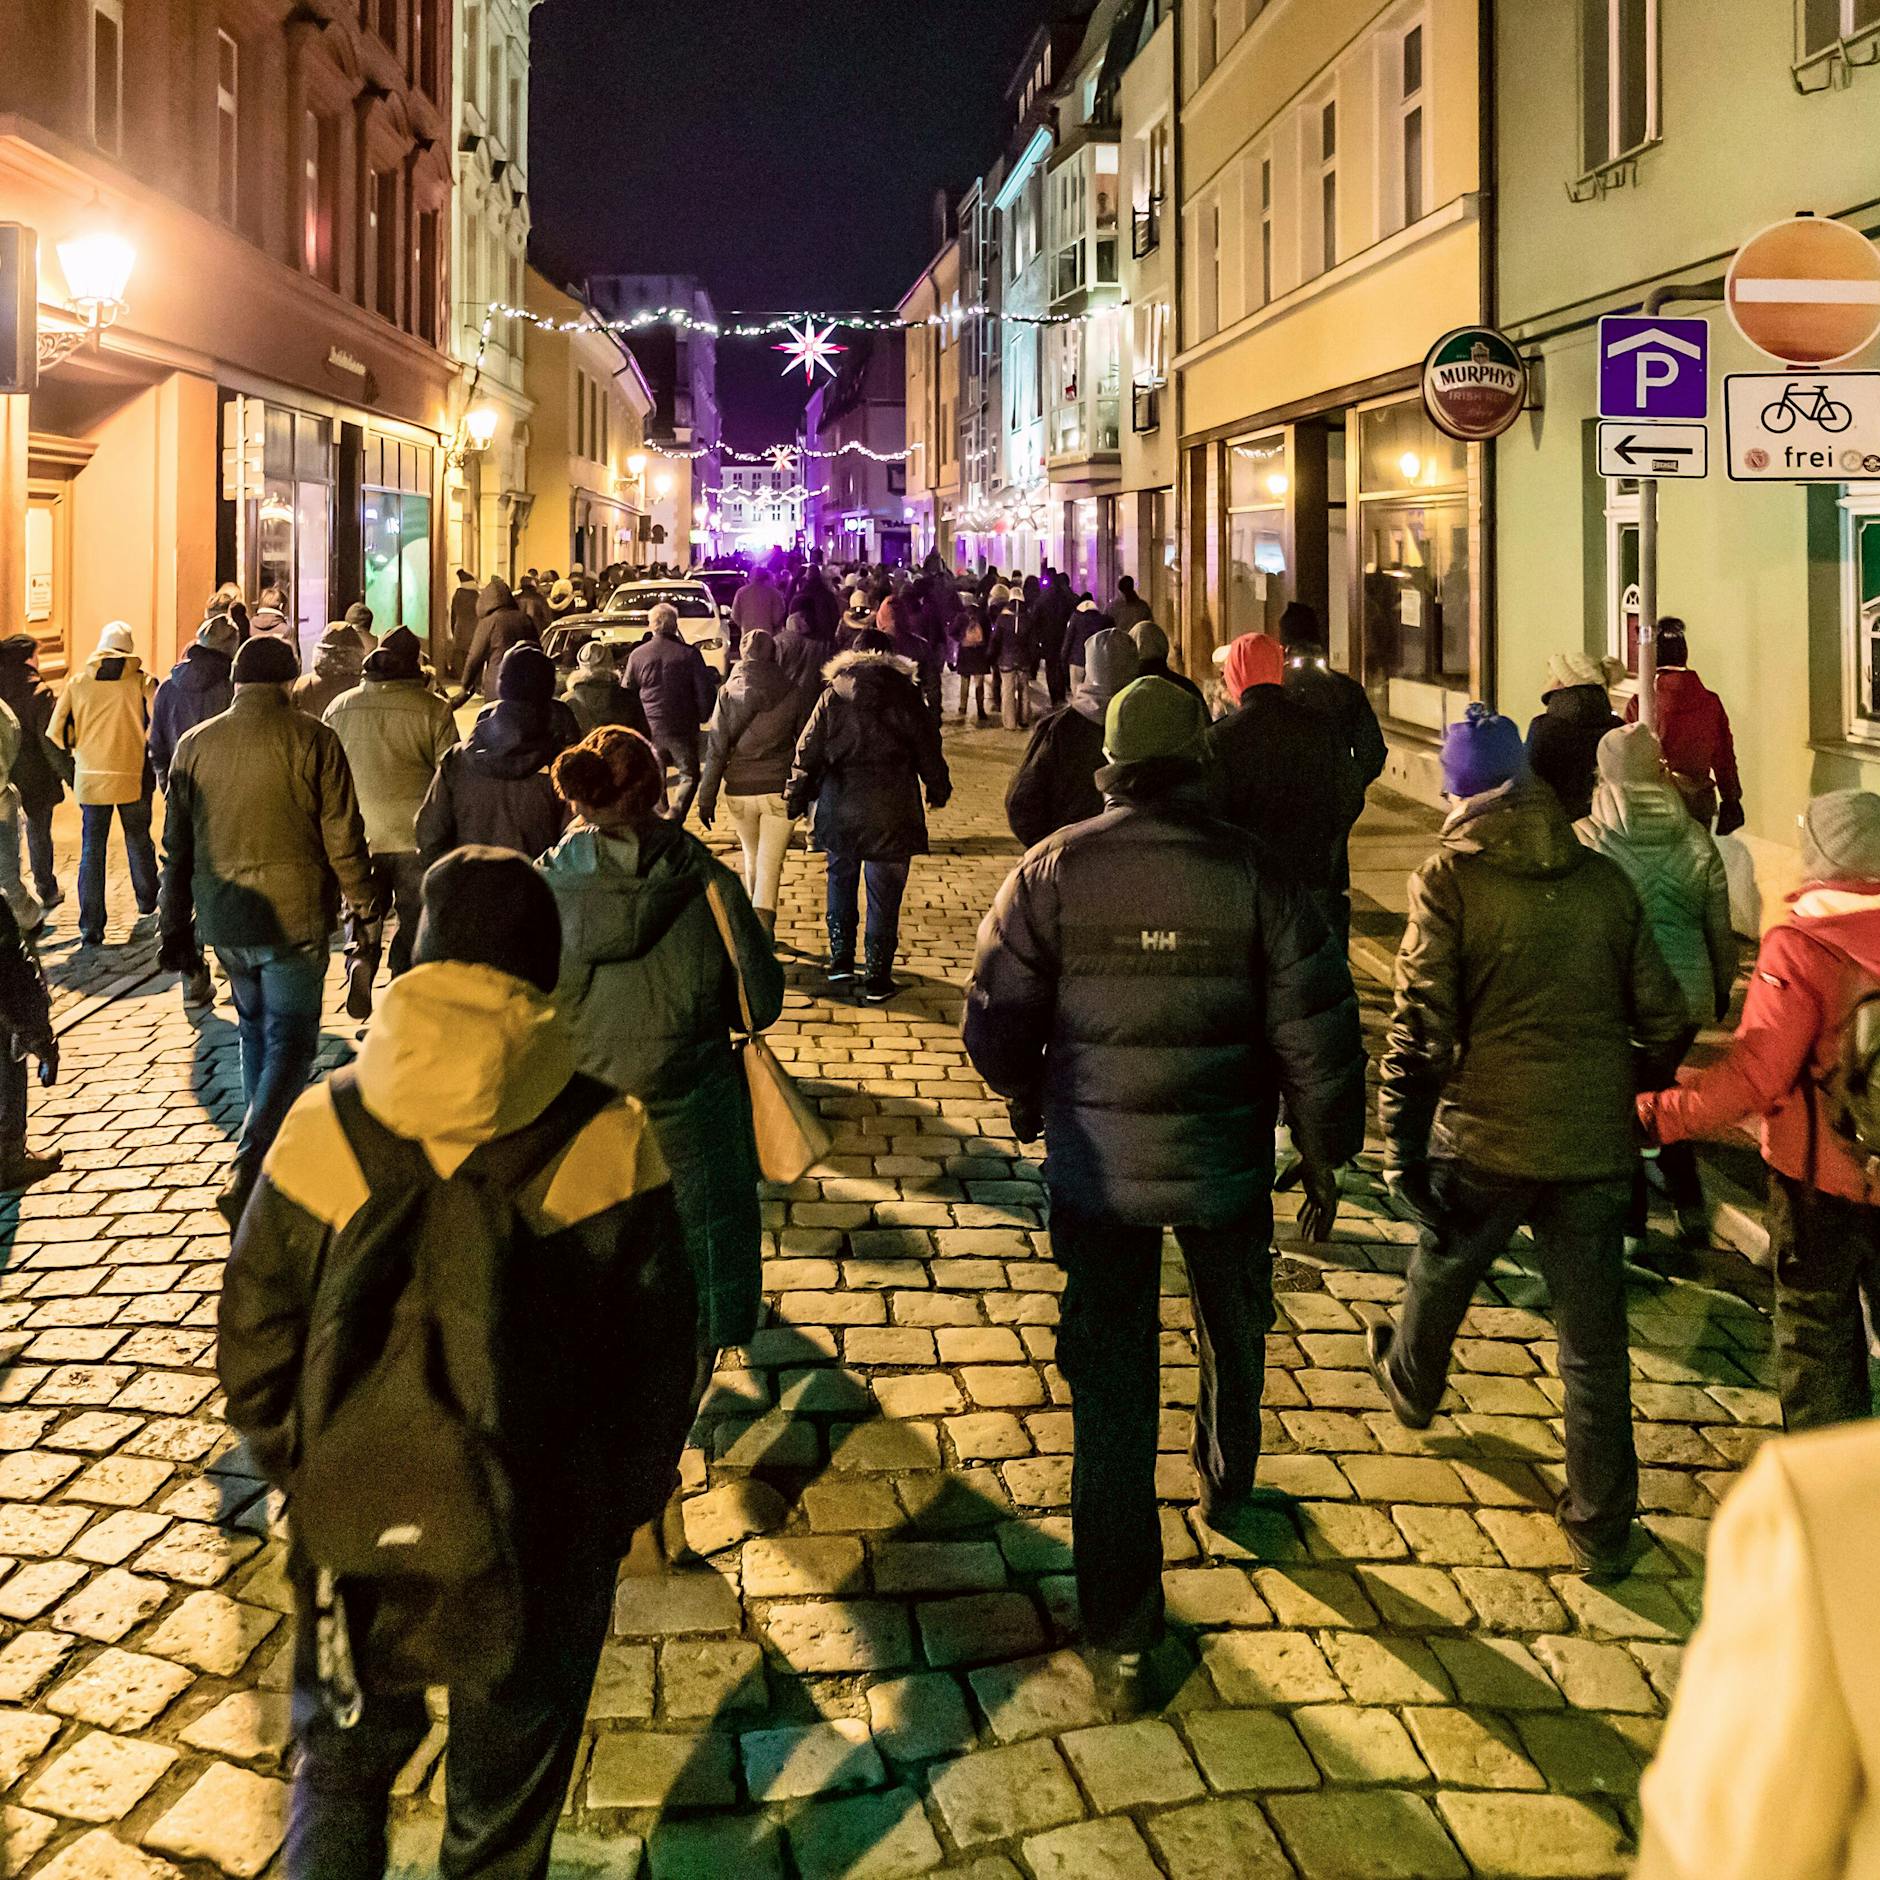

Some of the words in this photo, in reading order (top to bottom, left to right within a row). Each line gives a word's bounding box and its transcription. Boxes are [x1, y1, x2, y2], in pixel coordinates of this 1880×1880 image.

[1636, 352, 1679, 408] P
[1448, 391, 1481, 401] IRISH
[1784, 445, 1833, 468] frei
[1141, 931, 1176, 951] HH
